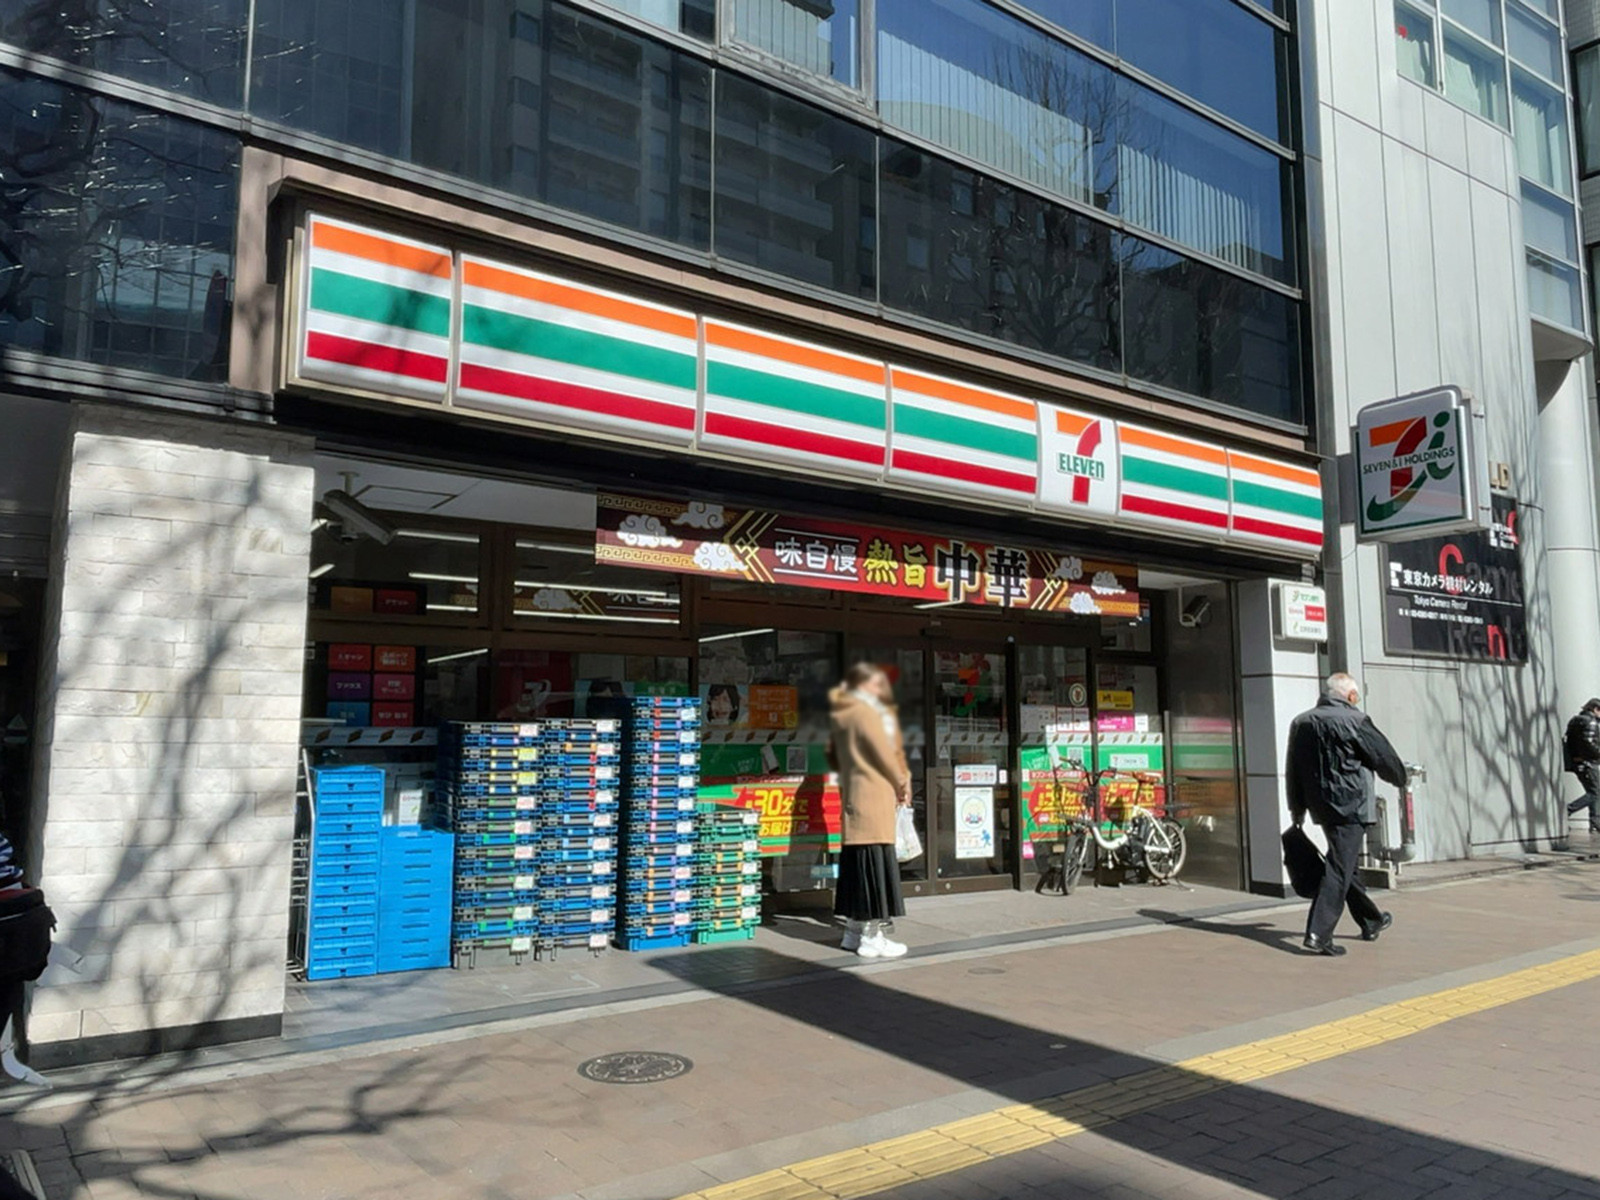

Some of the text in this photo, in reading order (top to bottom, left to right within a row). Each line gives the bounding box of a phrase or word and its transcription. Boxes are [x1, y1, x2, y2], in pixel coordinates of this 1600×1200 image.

[1404, 446, 1455, 466] HOLDINGS
[774, 537, 858, 574] 味自慢
[1403, 569, 1494, 595] 東京カメラ機材レンタル
